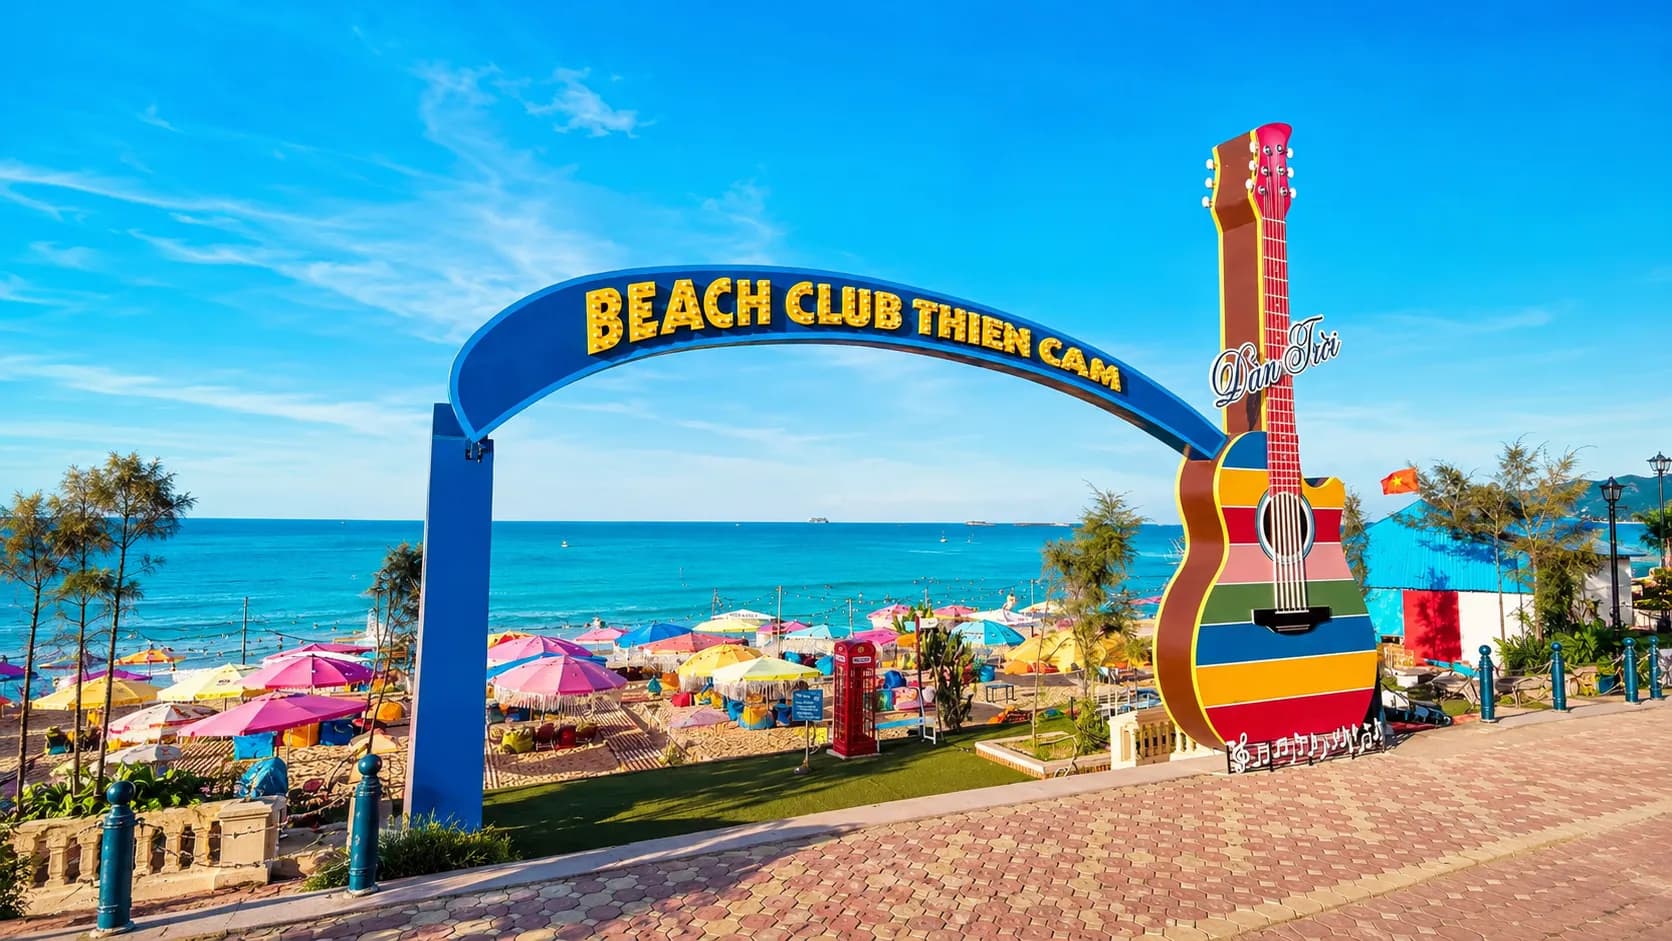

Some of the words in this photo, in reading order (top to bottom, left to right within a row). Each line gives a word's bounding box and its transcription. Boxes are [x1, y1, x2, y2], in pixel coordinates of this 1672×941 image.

[585, 276, 771, 356] BEACH
[785, 281, 902, 331] CLUB
[912, 298, 1031, 358] THIEN
[1038, 337, 1122, 392] CAM
